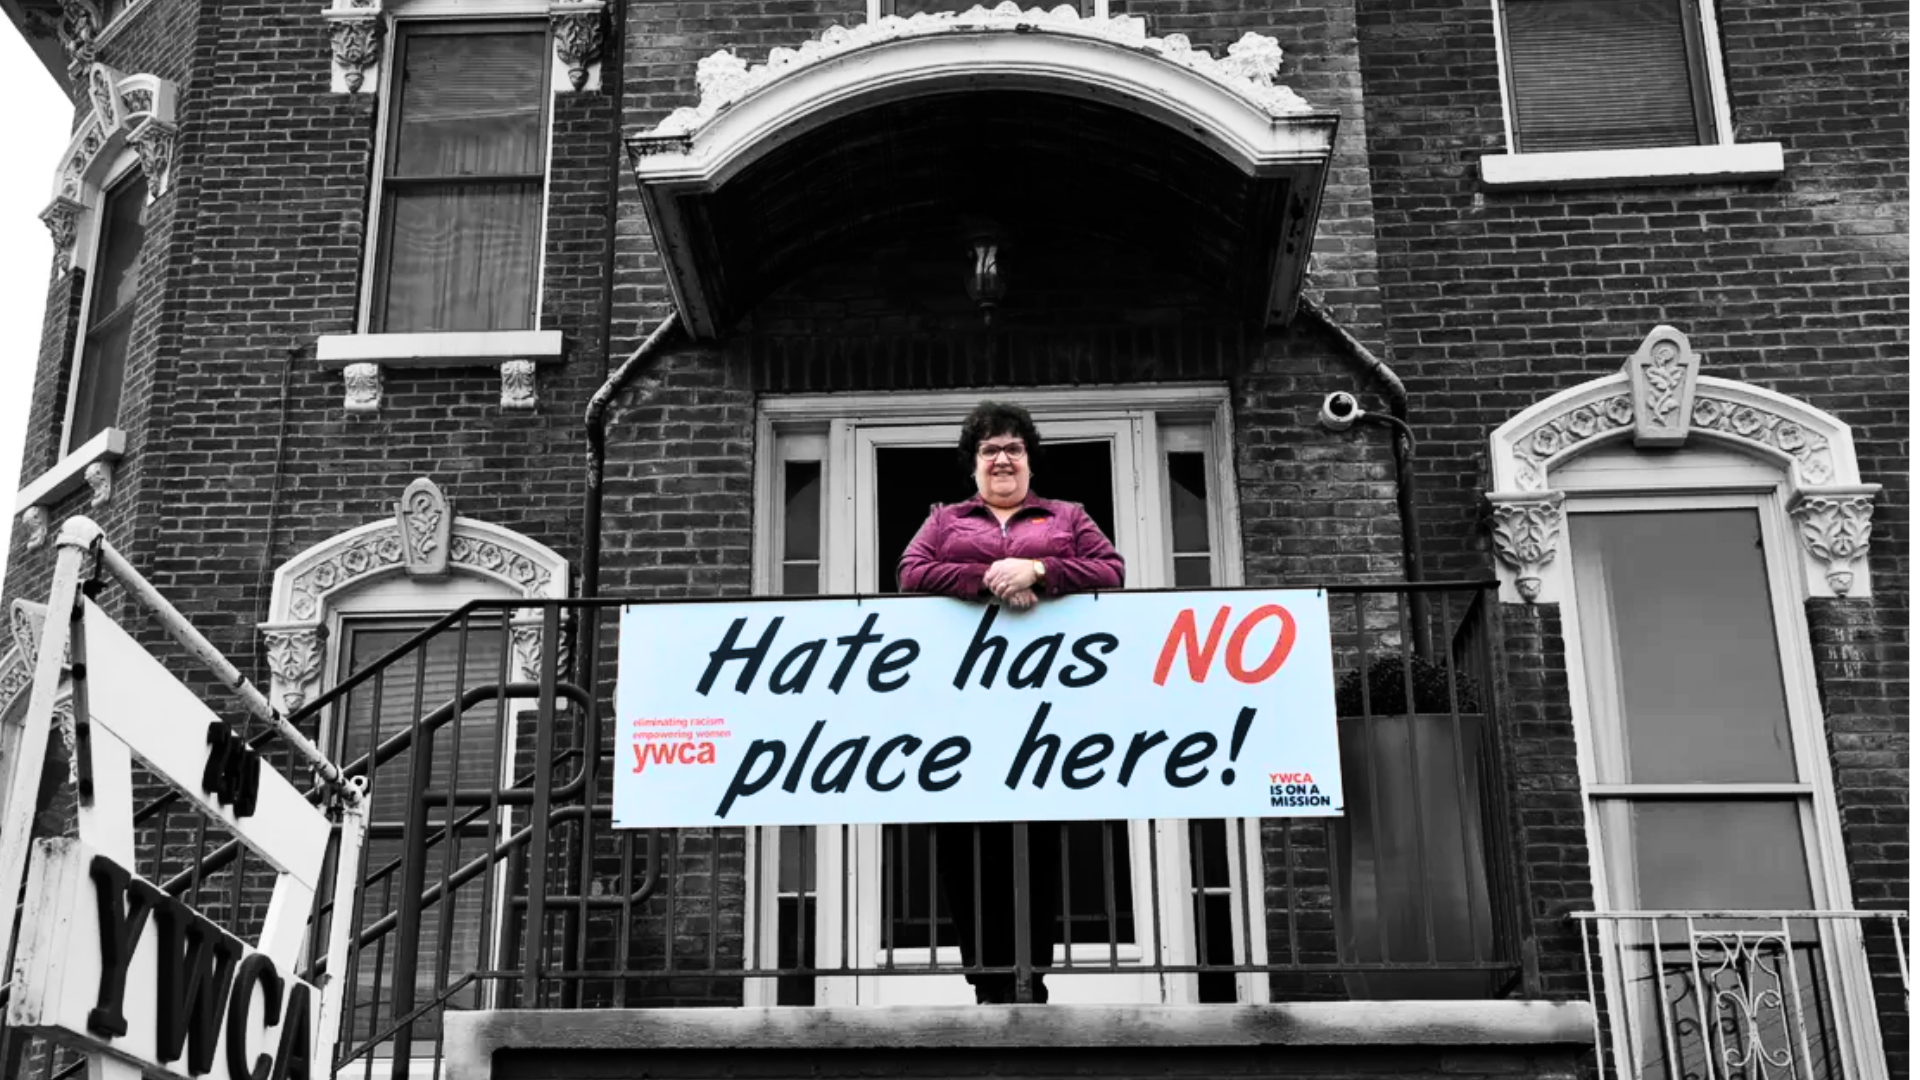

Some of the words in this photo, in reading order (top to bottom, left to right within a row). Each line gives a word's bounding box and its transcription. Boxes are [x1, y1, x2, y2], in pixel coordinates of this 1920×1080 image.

[696, 612, 921, 697] Hate
[952, 603, 1119, 690] has
[1152, 603, 1297, 687] NO
[632, 717, 688, 728] eliminating
[690, 717, 725, 726] racism
[632, 729, 693, 740] empowering
[695, 730, 731, 739] women
[632, 741, 716, 774] ywca
[714, 719, 972, 819] place
[1004, 702, 1261, 792] here!
[1269, 773, 1313, 784] YWCA
[1270, 785, 1283, 796] IS
[1286, 784, 1306, 795] ON
[1310, 784, 1320, 795] A
[1270, 796, 1330, 807] MISSION
[87, 855, 310, 1080] YWCA
